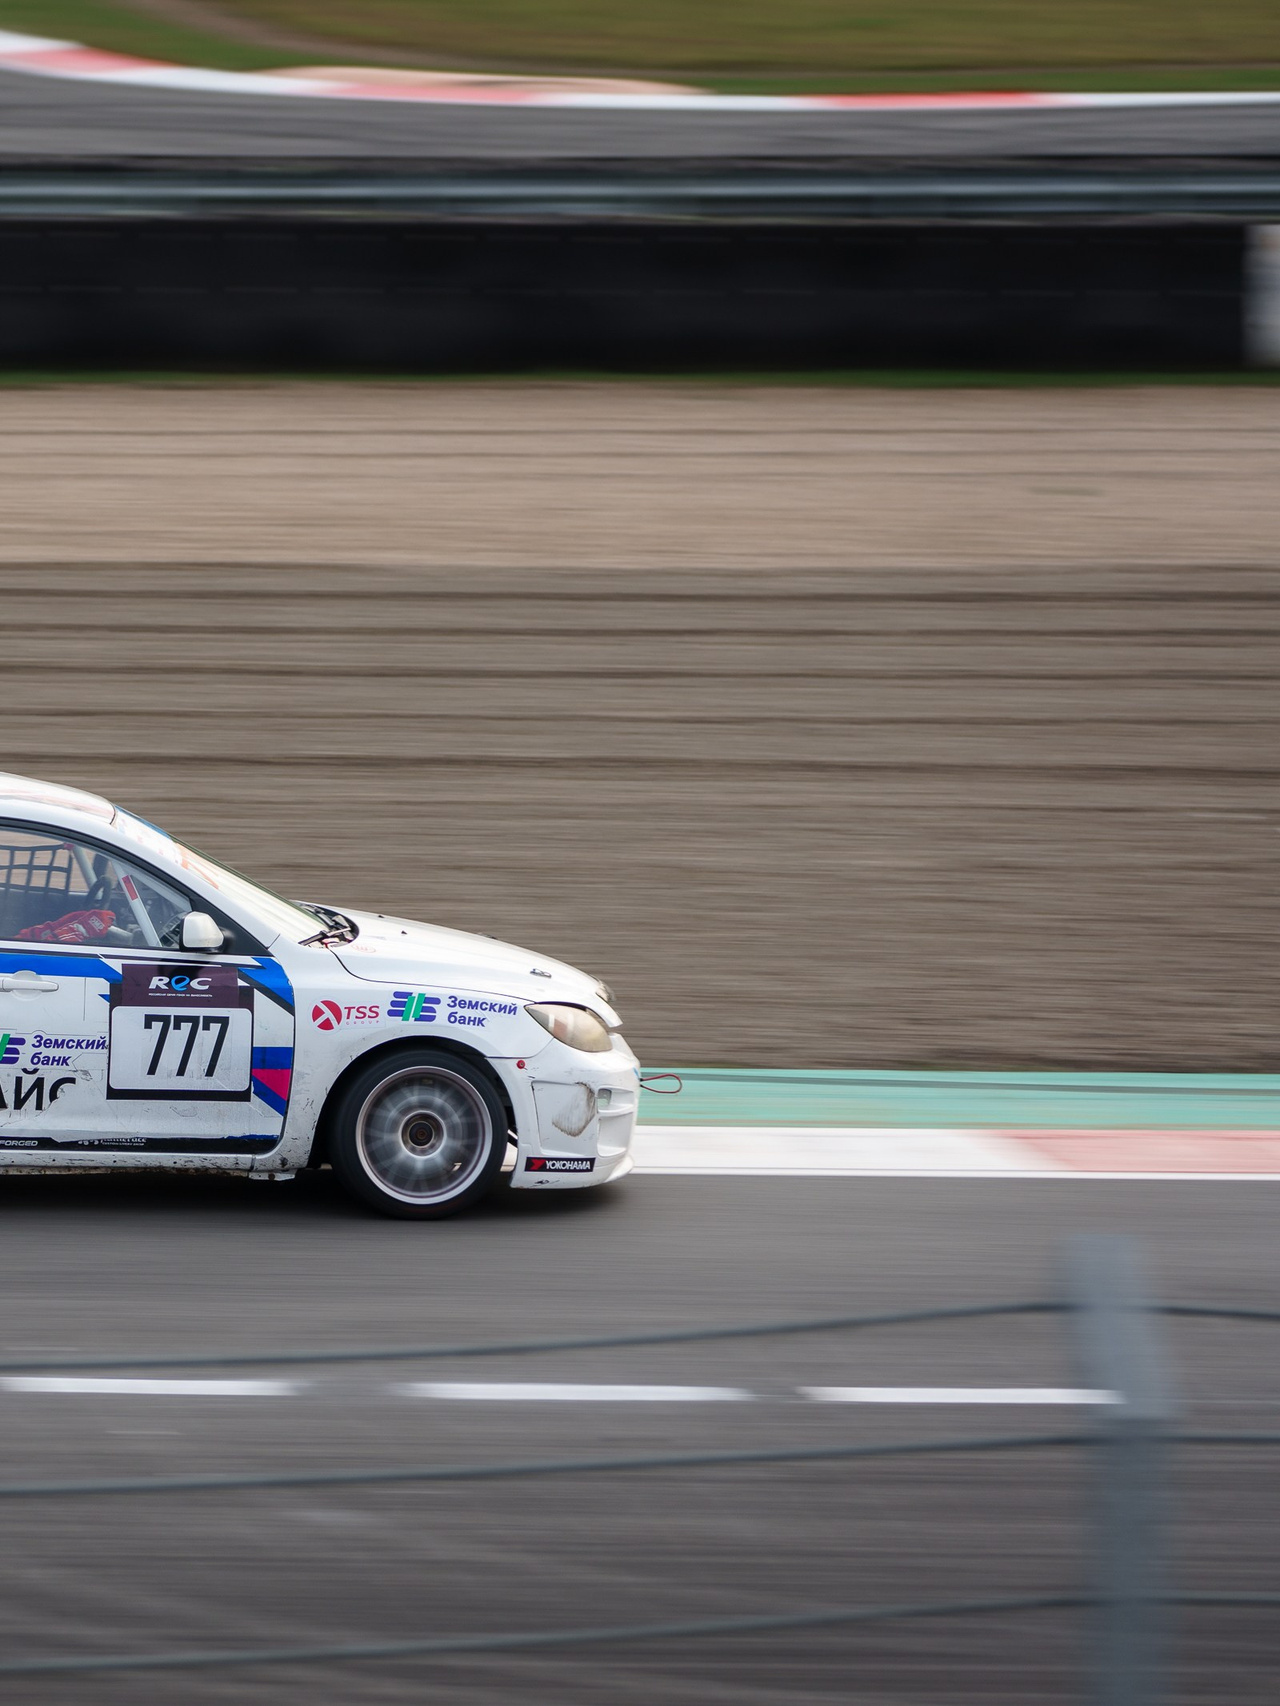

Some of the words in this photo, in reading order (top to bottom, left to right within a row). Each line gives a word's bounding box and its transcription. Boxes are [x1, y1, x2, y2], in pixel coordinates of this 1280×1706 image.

[344, 1005, 380, 1019] TSS
[447, 995, 518, 1016] Земский
[447, 1012, 487, 1027] банк
[31, 1034, 107, 1050] Земский
[144, 1014, 230, 1077] 777
[30, 1052, 72, 1066] банк
[545, 1160, 591, 1170] YOKOHAMA
